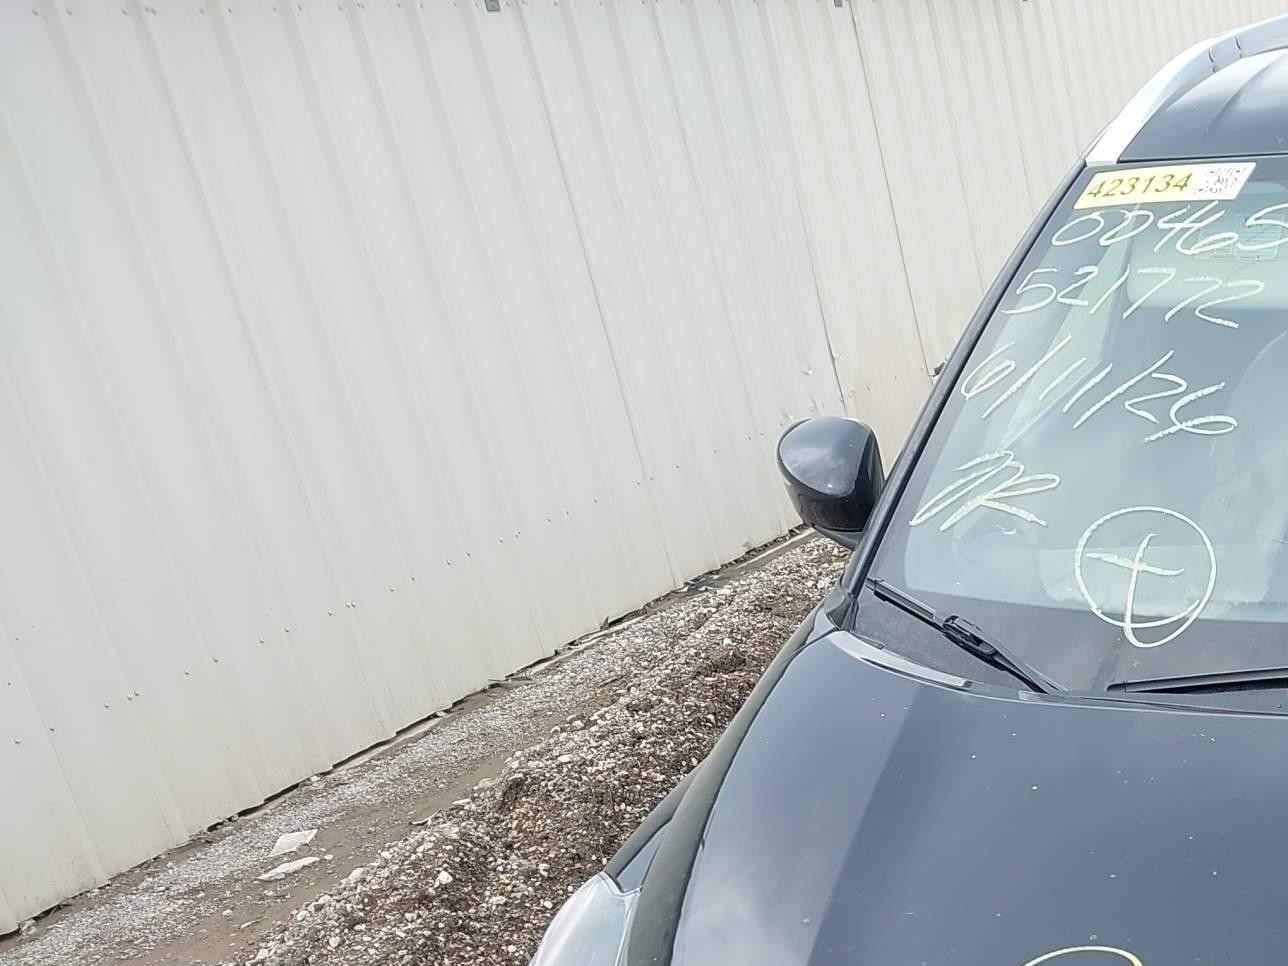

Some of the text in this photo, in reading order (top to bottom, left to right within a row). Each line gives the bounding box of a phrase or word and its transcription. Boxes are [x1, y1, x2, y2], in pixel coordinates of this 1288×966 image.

[1087, 172, 1193, 199] 423134
[1001, 263, 1265, 328] 521772
[960, 333, 1238, 444] 6/11/26
